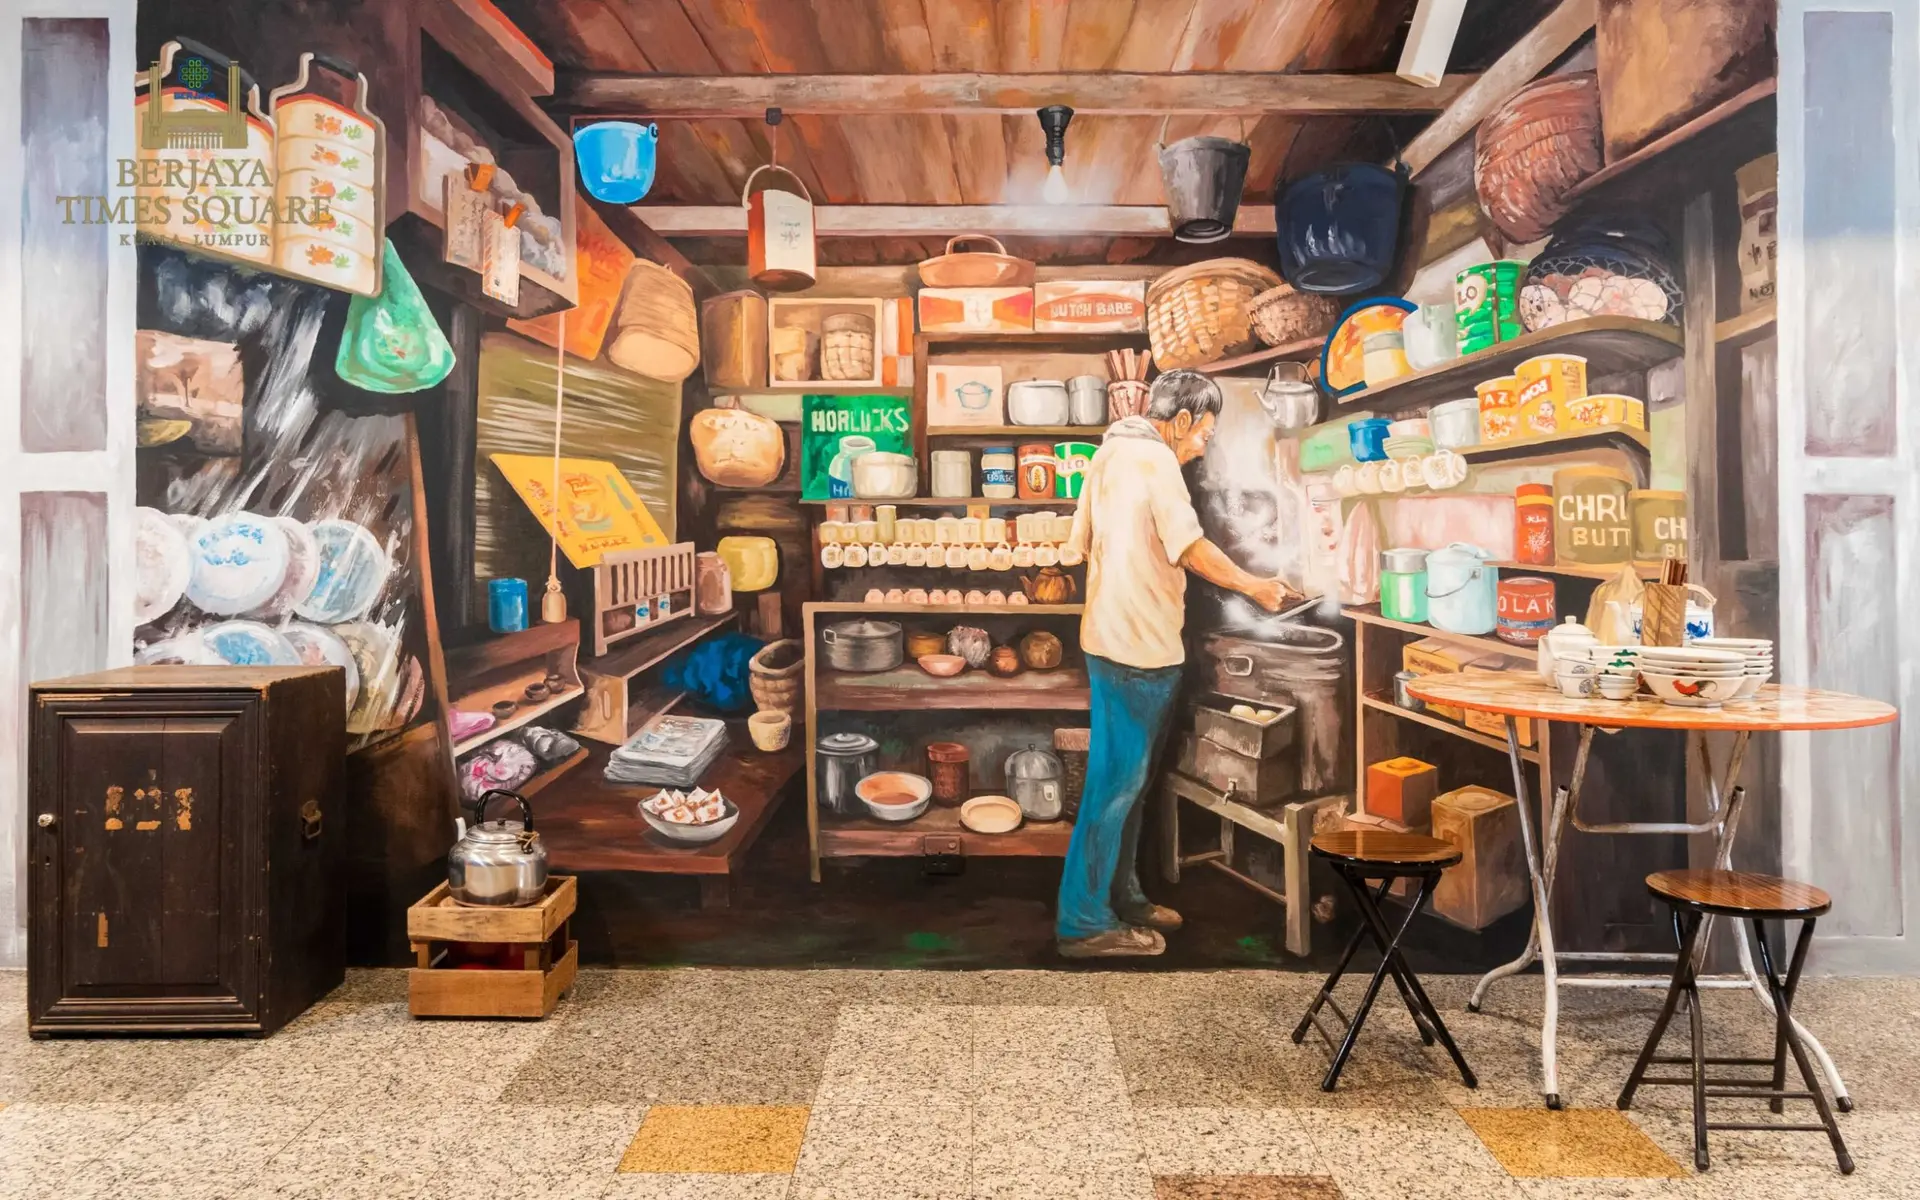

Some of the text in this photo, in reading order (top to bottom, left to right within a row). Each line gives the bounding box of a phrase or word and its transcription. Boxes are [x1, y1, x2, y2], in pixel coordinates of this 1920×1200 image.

[1050, 302, 1133, 317] DUTCH BABE
[1654, 516, 1687, 540] CH
